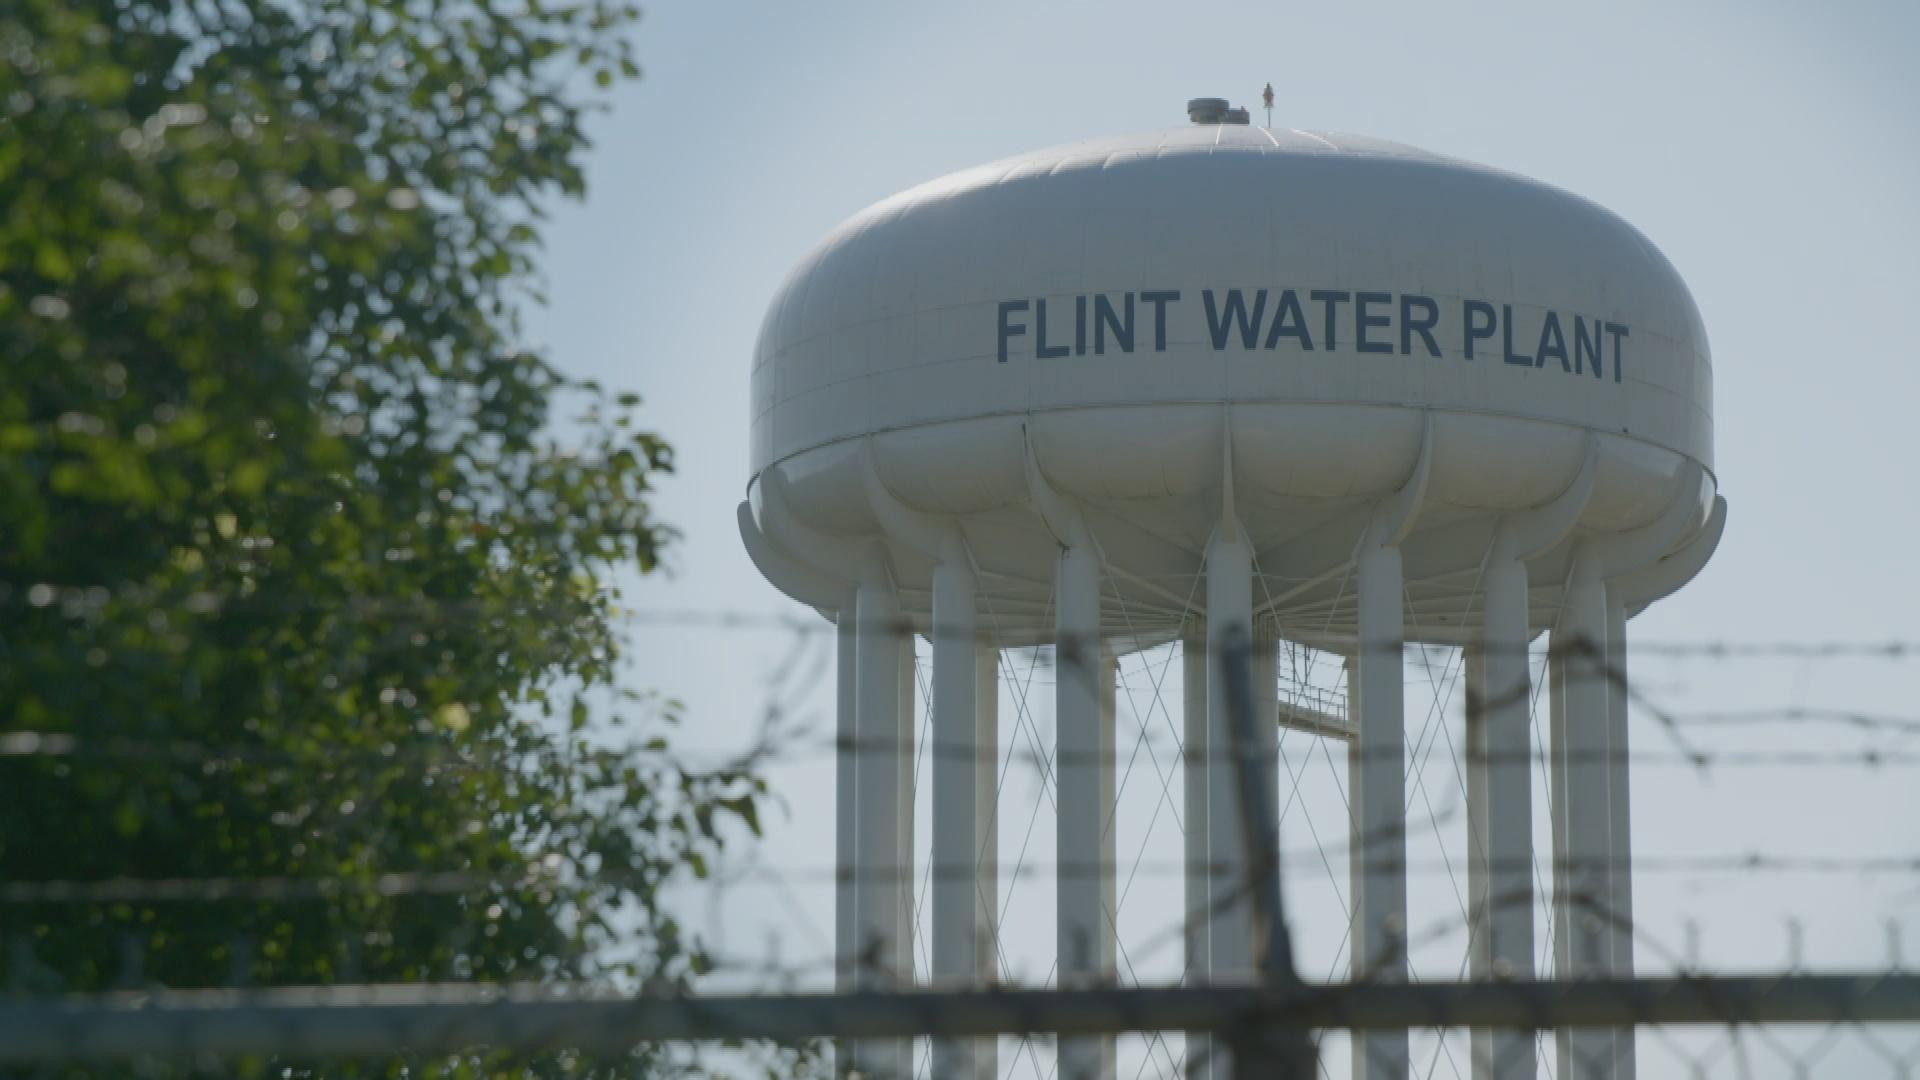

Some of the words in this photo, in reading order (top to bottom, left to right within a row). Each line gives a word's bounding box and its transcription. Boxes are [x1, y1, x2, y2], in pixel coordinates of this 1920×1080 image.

[997, 291, 1181, 363] FLINT
[1202, 289, 1442, 358] WATER
[1463, 299, 1630, 383] PLANT
